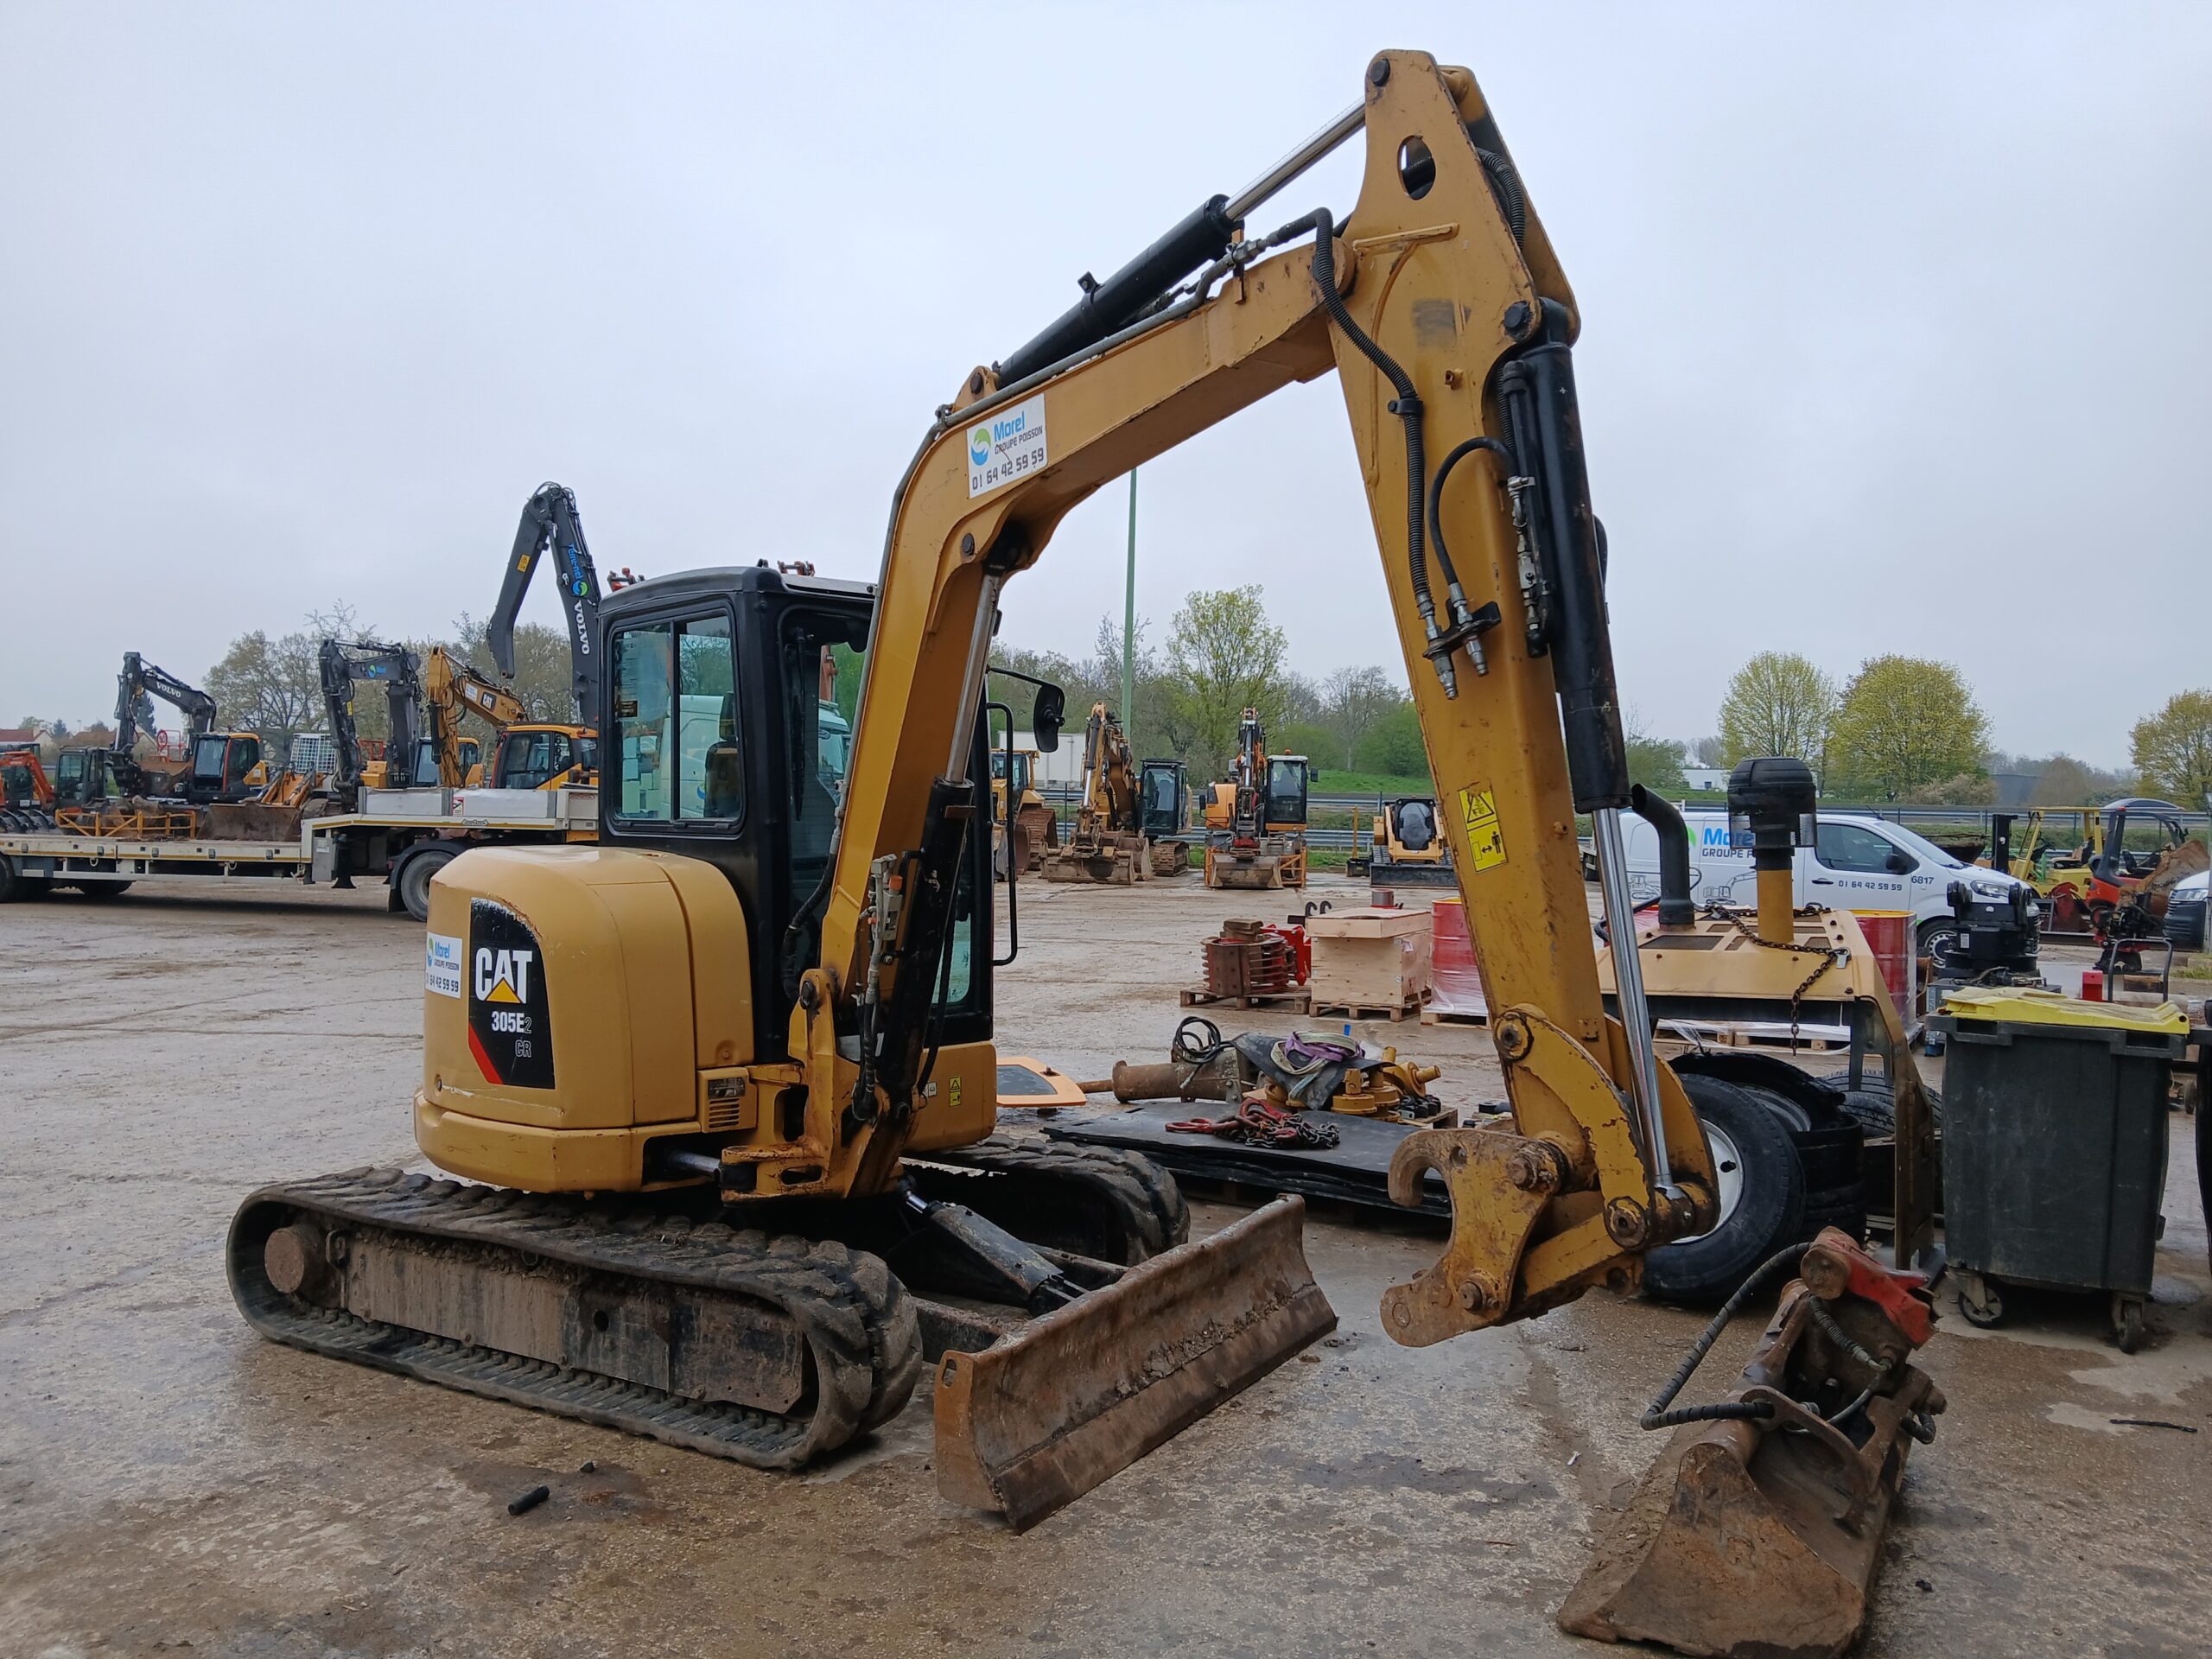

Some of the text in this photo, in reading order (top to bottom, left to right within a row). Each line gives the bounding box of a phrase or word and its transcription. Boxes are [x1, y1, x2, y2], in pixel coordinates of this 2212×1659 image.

[994, 410, 1025, 442] Morel
[995, 425, 1043, 454] GROUPE POISSON
[972, 447, 1044, 491] 01 64 42 59 59
[574, 600, 590, 655] VOLVO
[156, 681, 181, 698] VOLVO
[482, 694, 493, 709] CAT
[1703, 828, 1755, 846] More
[1702, 848, 1744, 858] GROUPE
[1910, 875, 1935, 885] 6817
[442, 977, 449, 990] 59
[450, 980, 459, 993] 59
[475, 947, 533, 1004] CAT
[491, 1010, 532, 1034] 305E2
[514, 1039, 532, 1058] CR
